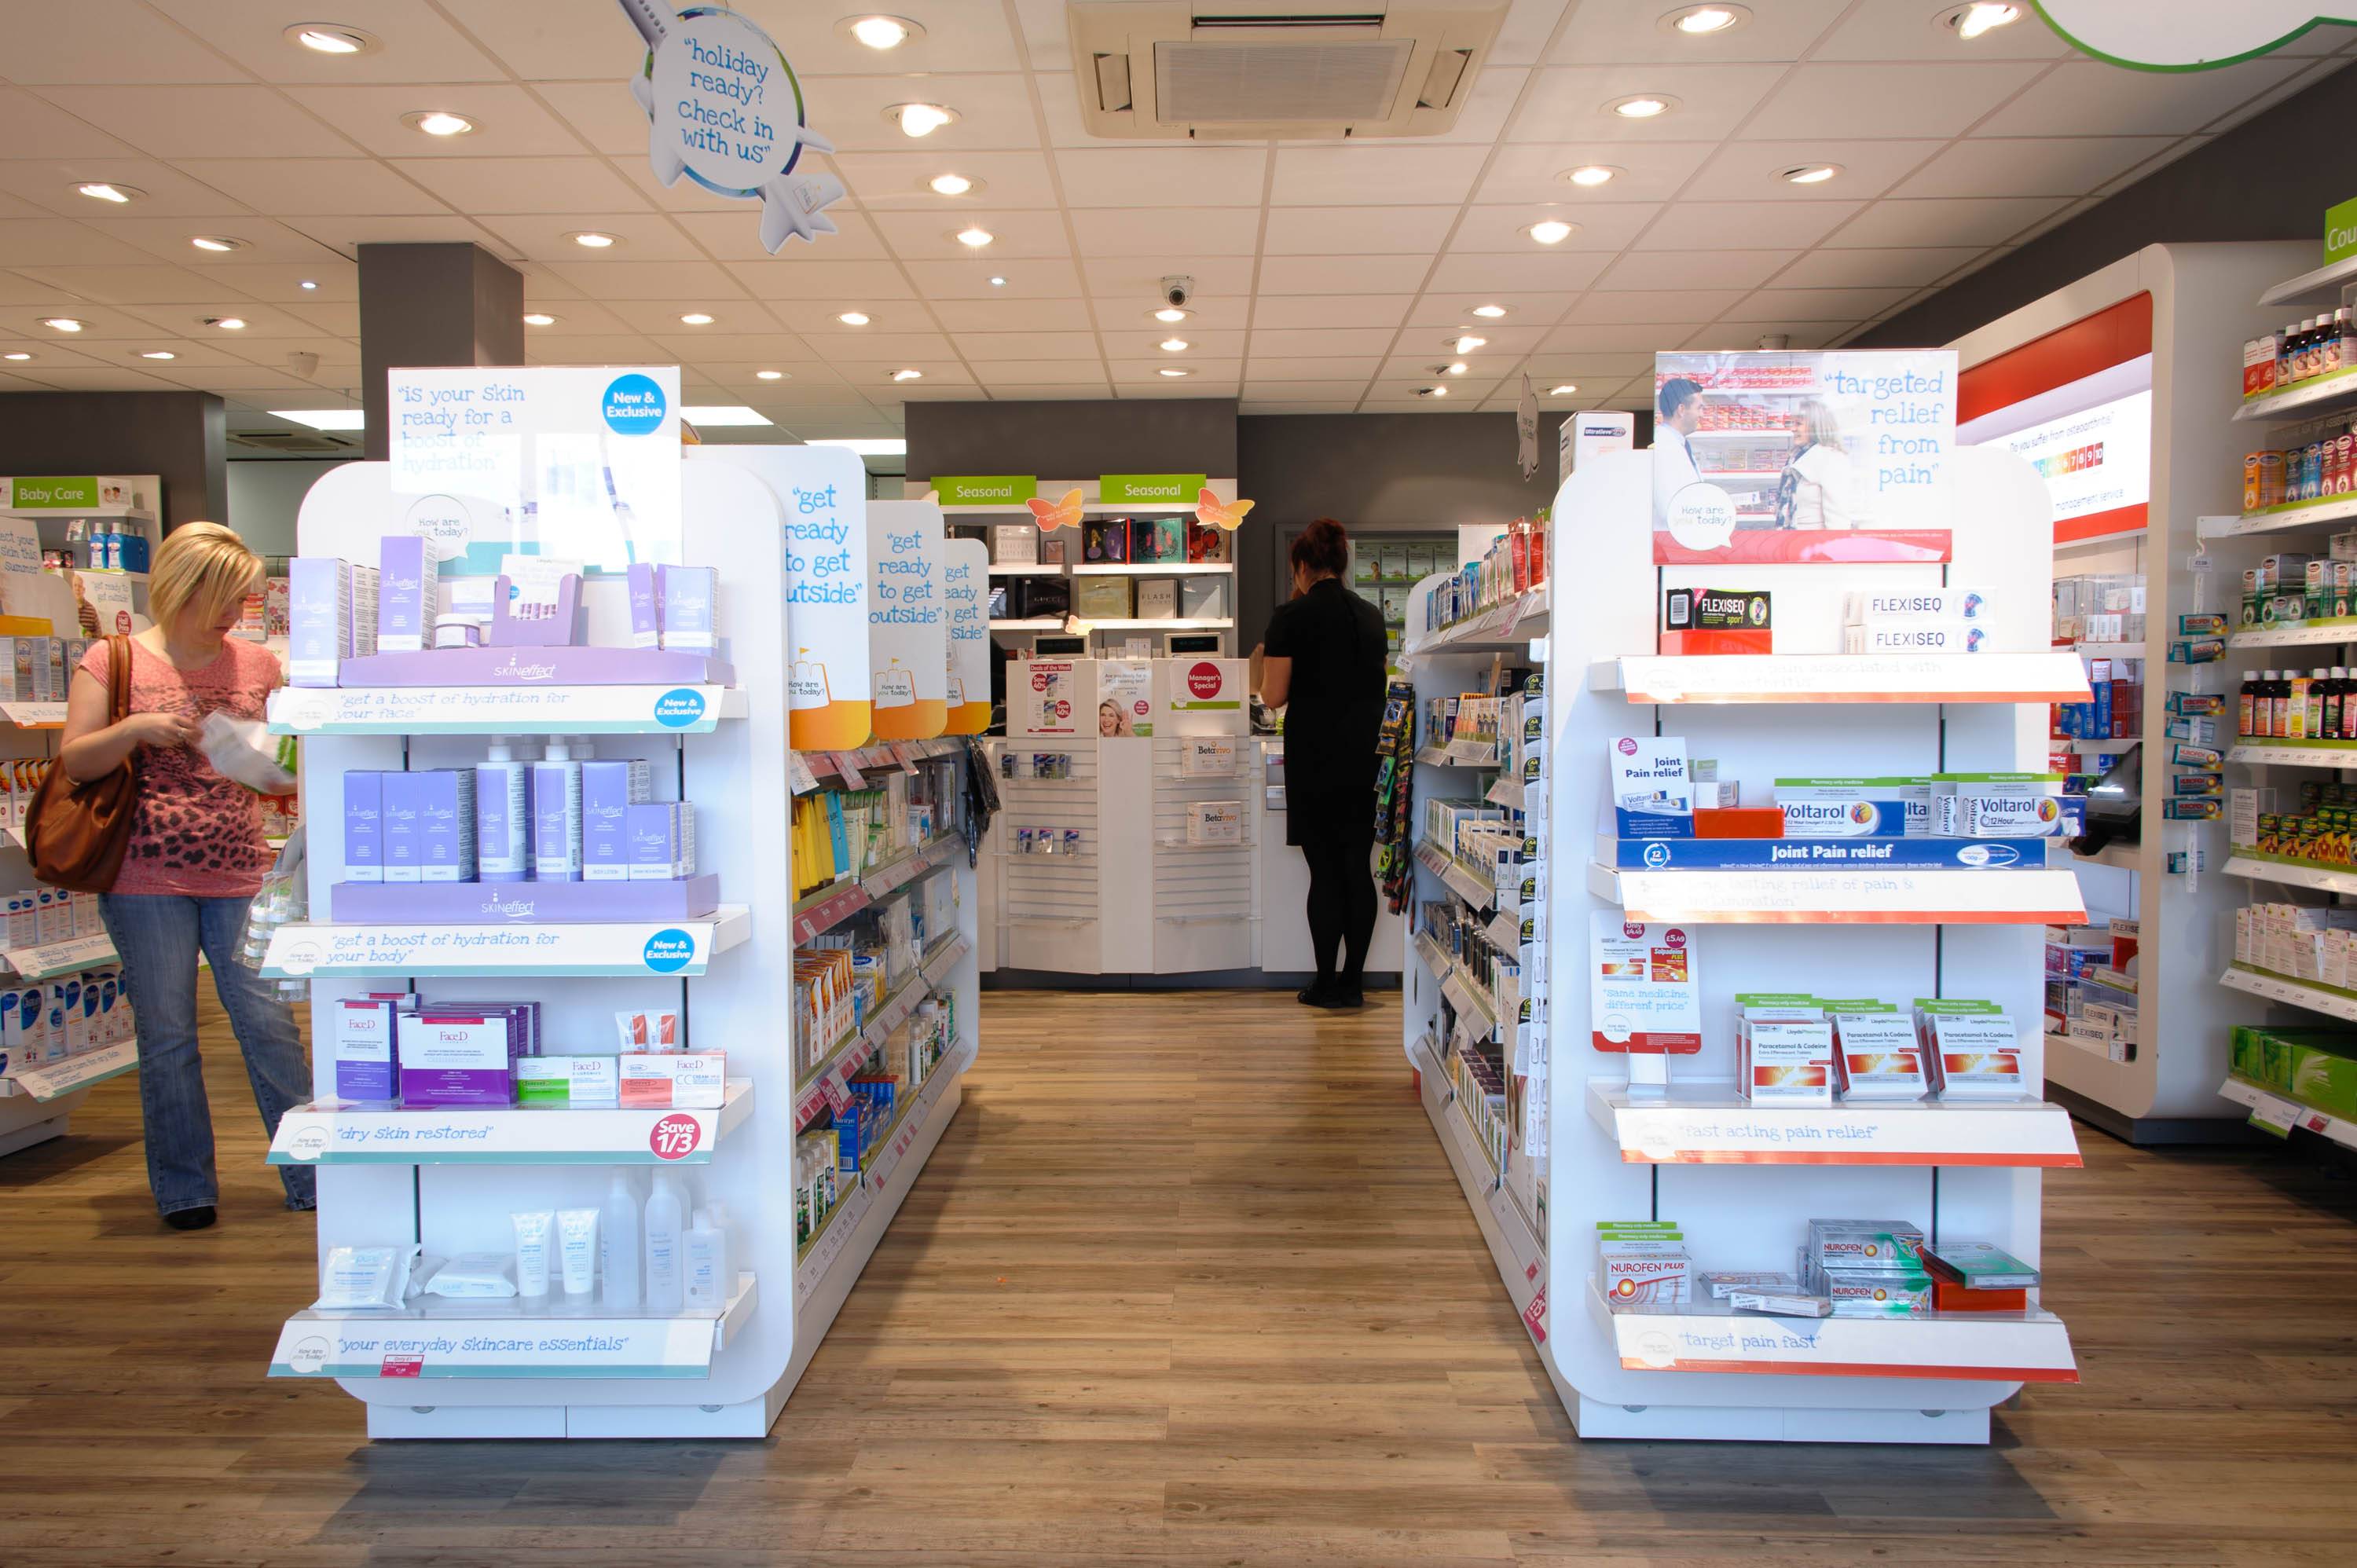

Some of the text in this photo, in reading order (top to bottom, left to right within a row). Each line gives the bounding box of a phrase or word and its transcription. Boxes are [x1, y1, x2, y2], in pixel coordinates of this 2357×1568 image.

[691, 71, 764, 105] ready?
[678, 99, 774, 141] check in
[681, 128, 728, 156] with
[430, 387, 475, 410] your
[482, 383, 525, 402] skin
[614, 391, 655, 405] New &
[402, 408, 512, 430] ready for a
[606, 405, 662, 418] Exclusive
[1871, 401, 1945, 425] relief
[402, 431, 485, 449] boost of
[1879, 433, 1940, 454] from
[2020, 440, 2029, 454] you
[2032, 433, 2048, 445] suffer
[2050, 430, 2065, 440] from
[2071, 448, 2102, 466] 7 8 9 10
[19, 487, 84, 502] Baby Care
[956, 485, 1013, 498] Seasonal
[1124, 484, 1181, 496] Seasonal
[2099, 488, 2124, 502] service
[1681, 505, 1725, 515] How are
[419, 518, 460, 527] How are
[1697, 515, 1732, 526] today?
[433, 526, 468, 538] today?
[786, 517, 849, 544] ready
[20, 548, 38, 560] this
[786, 548, 850, 577] to get
[878, 557, 932, 578] ready
[786, 582, 862, 603] utside"
[878, 581, 933, 603] to get
[944, 584, 977, 602] eady
[1702, 599, 1744, 614] FLEXISEQ
[1872, 598, 1941, 612] FLEXISEQ
[954, 603, 978, 623] get
[1726, 615, 1743, 625] sport
[951, 625, 986, 639] side"
[1876, 632, 1945, 647] FLEXISEQ
[1810, 661, 1942, 674] associated with
[376, 694, 386, 705] a
[390, 693, 436, 705] boost
[441, 691, 460, 705] of
[461, 691, 544, 706] hydration
[547, 691, 570, 705] for
[664, 698, 698, 708] New &
[335, 709, 373, 721] your
[656, 707, 702, 716] Exclusive
[1198, 746, 1231, 754] Betavivo
[1655, 757, 1681, 768] Joint
[1626, 768, 1683, 778] Pain relief
[1780, 803, 1846, 819] Voltarol
[1981, 798, 2036, 812] Voltarol
[1205, 813, 1237, 822] Betavivo
[1772, 844, 1892, 860] Joint Pain relief
[1791, 878, 1838, 890] relief
[1842, 878, 1858, 890] of
[1863, 880, 1898, 895] pain
[1904, 880, 1914, 891] &
[481, 899, 536, 917] SKINeffect
[367, 935, 377, 946] a
[381, 932, 427, 946] boost
[431, 932, 451, 946] of
[452, 932, 533, 947] hydration
[535, 932, 559, 946] for
[653, 941, 687, 950] New &
[326, 951, 365, 965] your
[646, 950, 691, 959] Exclusive
[1605, 1000, 1653, 1009] different
[2073, 1027, 2104, 1040] FLEXISEQ
[375, 1124, 410, 1139] skin
[658, 1120, 696, 1134] Save
[1725, 1124, 1780, 1141] acting
[1785, 1126, 1824, 1141] pain
[656, 1133, 693, 1154] 1/3
[1611, 1262, 1662, 1273] NUROFEN
[383, 1336, 457, 1354] everyday
[462, 1335, 533, 1351] skincare
[1742, 1334, 1777, 1350] pain
